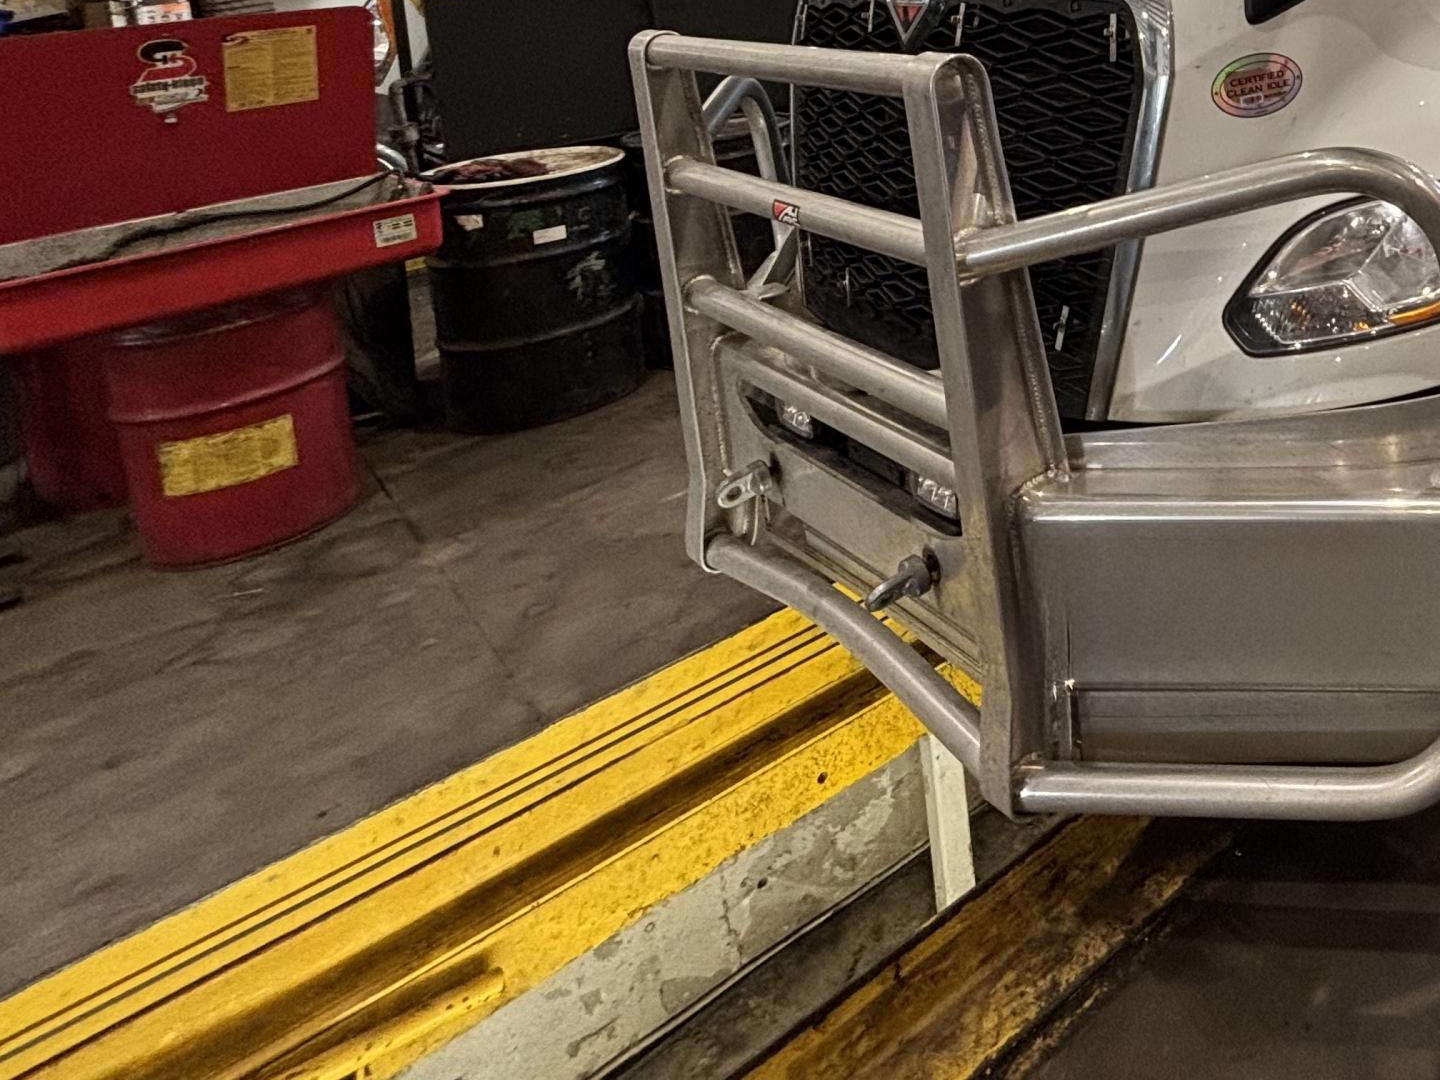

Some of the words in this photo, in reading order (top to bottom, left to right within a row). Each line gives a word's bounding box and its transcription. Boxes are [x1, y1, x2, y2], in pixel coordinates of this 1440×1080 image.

[1230, 71, 1284, 87] CERTIFIED
[1226, 85, 1263, 98] CLEAN
[1267, 79, 1290, 90] IDLE
